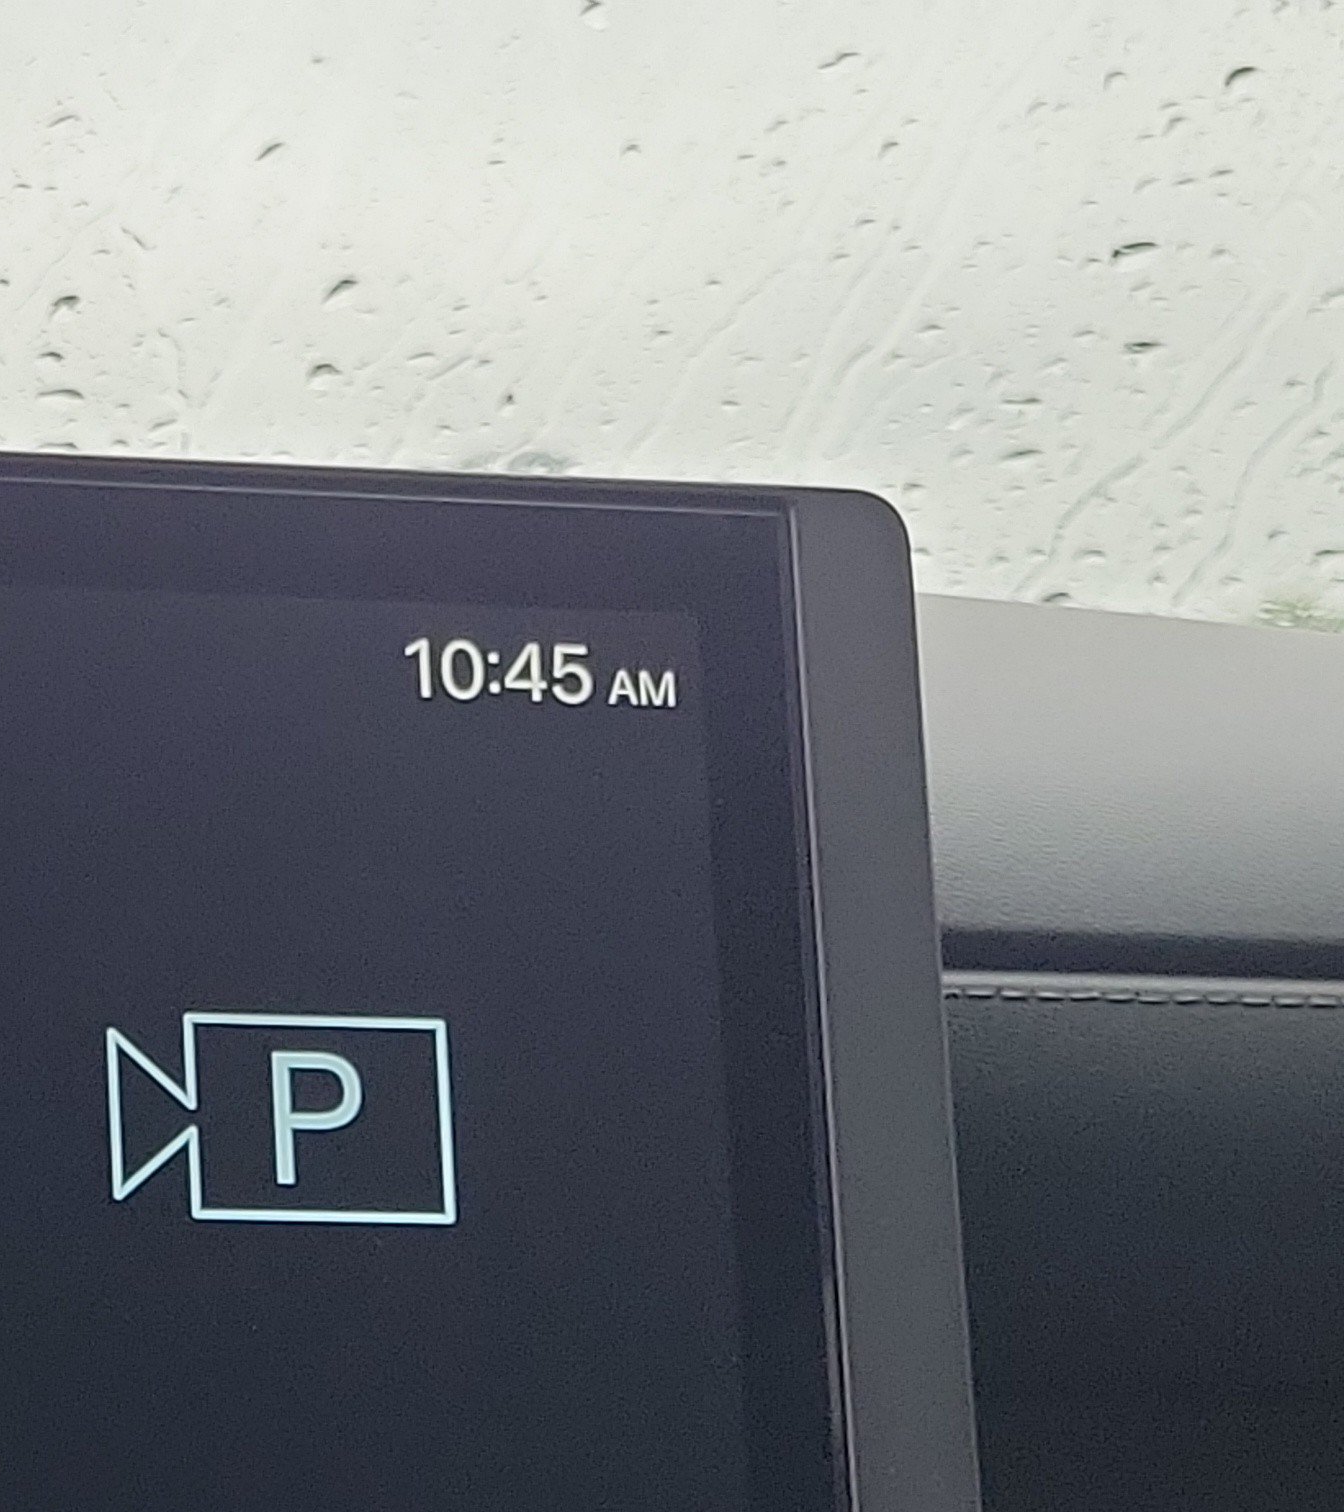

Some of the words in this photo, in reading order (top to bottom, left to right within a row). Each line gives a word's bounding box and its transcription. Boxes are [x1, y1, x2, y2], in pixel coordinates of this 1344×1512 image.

[404, 637, 594, 705] 10:45
[608, 668, 676, 707] AM
[271, 1051, 362, 1185] P
